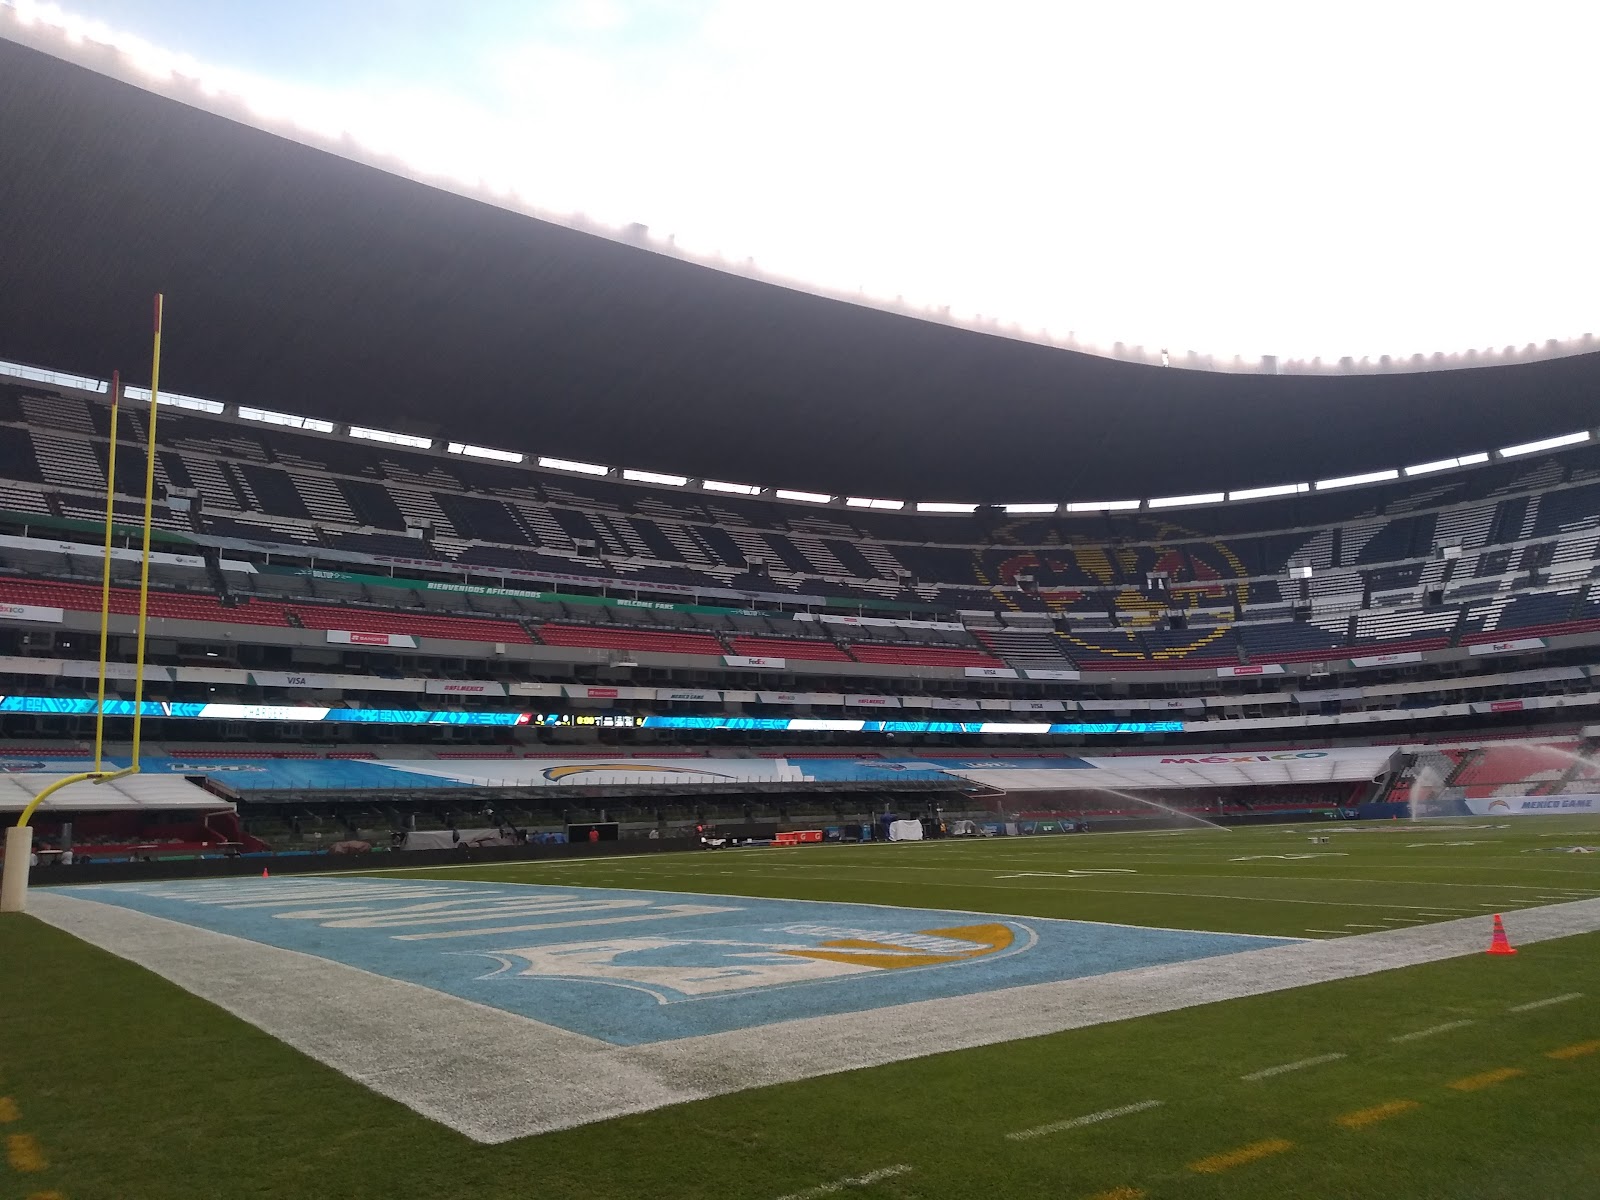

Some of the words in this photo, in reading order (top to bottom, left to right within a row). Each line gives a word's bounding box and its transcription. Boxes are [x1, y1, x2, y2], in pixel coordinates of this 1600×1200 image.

[450, 563, 503, 574] NFL
[510, 570, 614, 585] MEXICO
[620, 580, 695, 592] GAME
[427, 582, 485, 594] BIENVENIDOS
[486, 587, 542, 599] AFICIONADOS
[617, 599, 653, 610] WELCOME
[654, 601, 674, 610] FANS
[359, 635, 388, 643] BANORTE
[748, 657, 766, 665] FedEx
[286, 677, 306, 685] VISA
[1521, 801, 1561, 809] MEXICO
[1561, 800, 1592, 808] GAME
